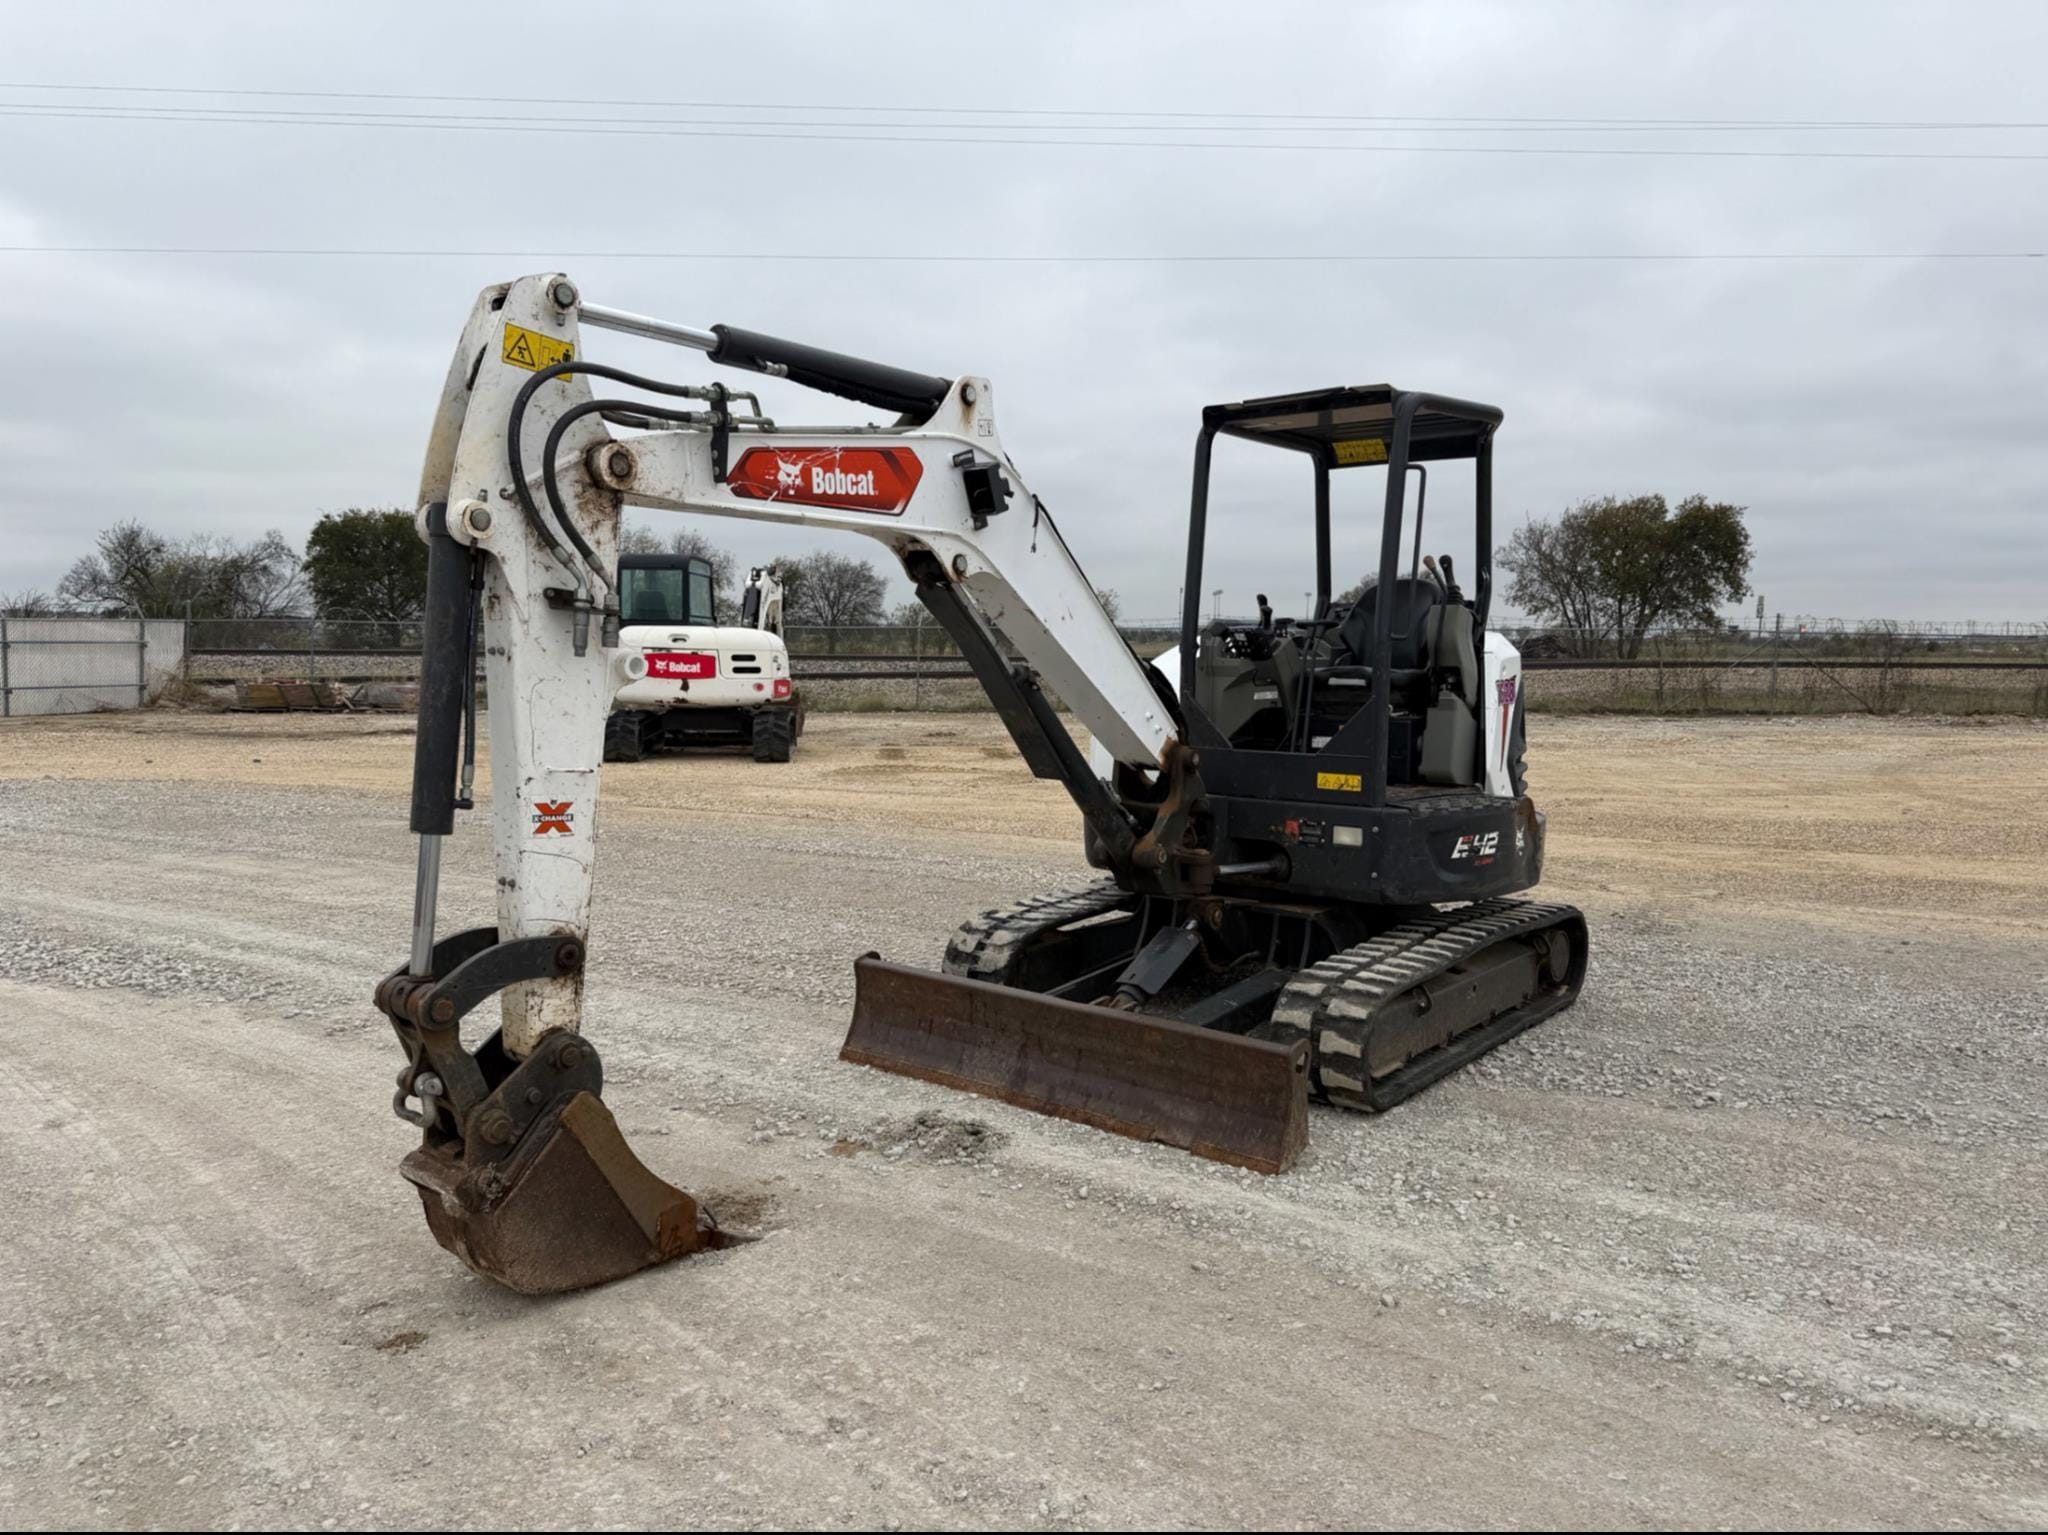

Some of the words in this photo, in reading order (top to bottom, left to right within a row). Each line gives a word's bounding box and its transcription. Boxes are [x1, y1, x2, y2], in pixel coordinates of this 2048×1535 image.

[811, 466, 876, 496] Bobcat
[668, 661, 701, 674] Bobcat
[1451, 831, 1499, 859] E42
